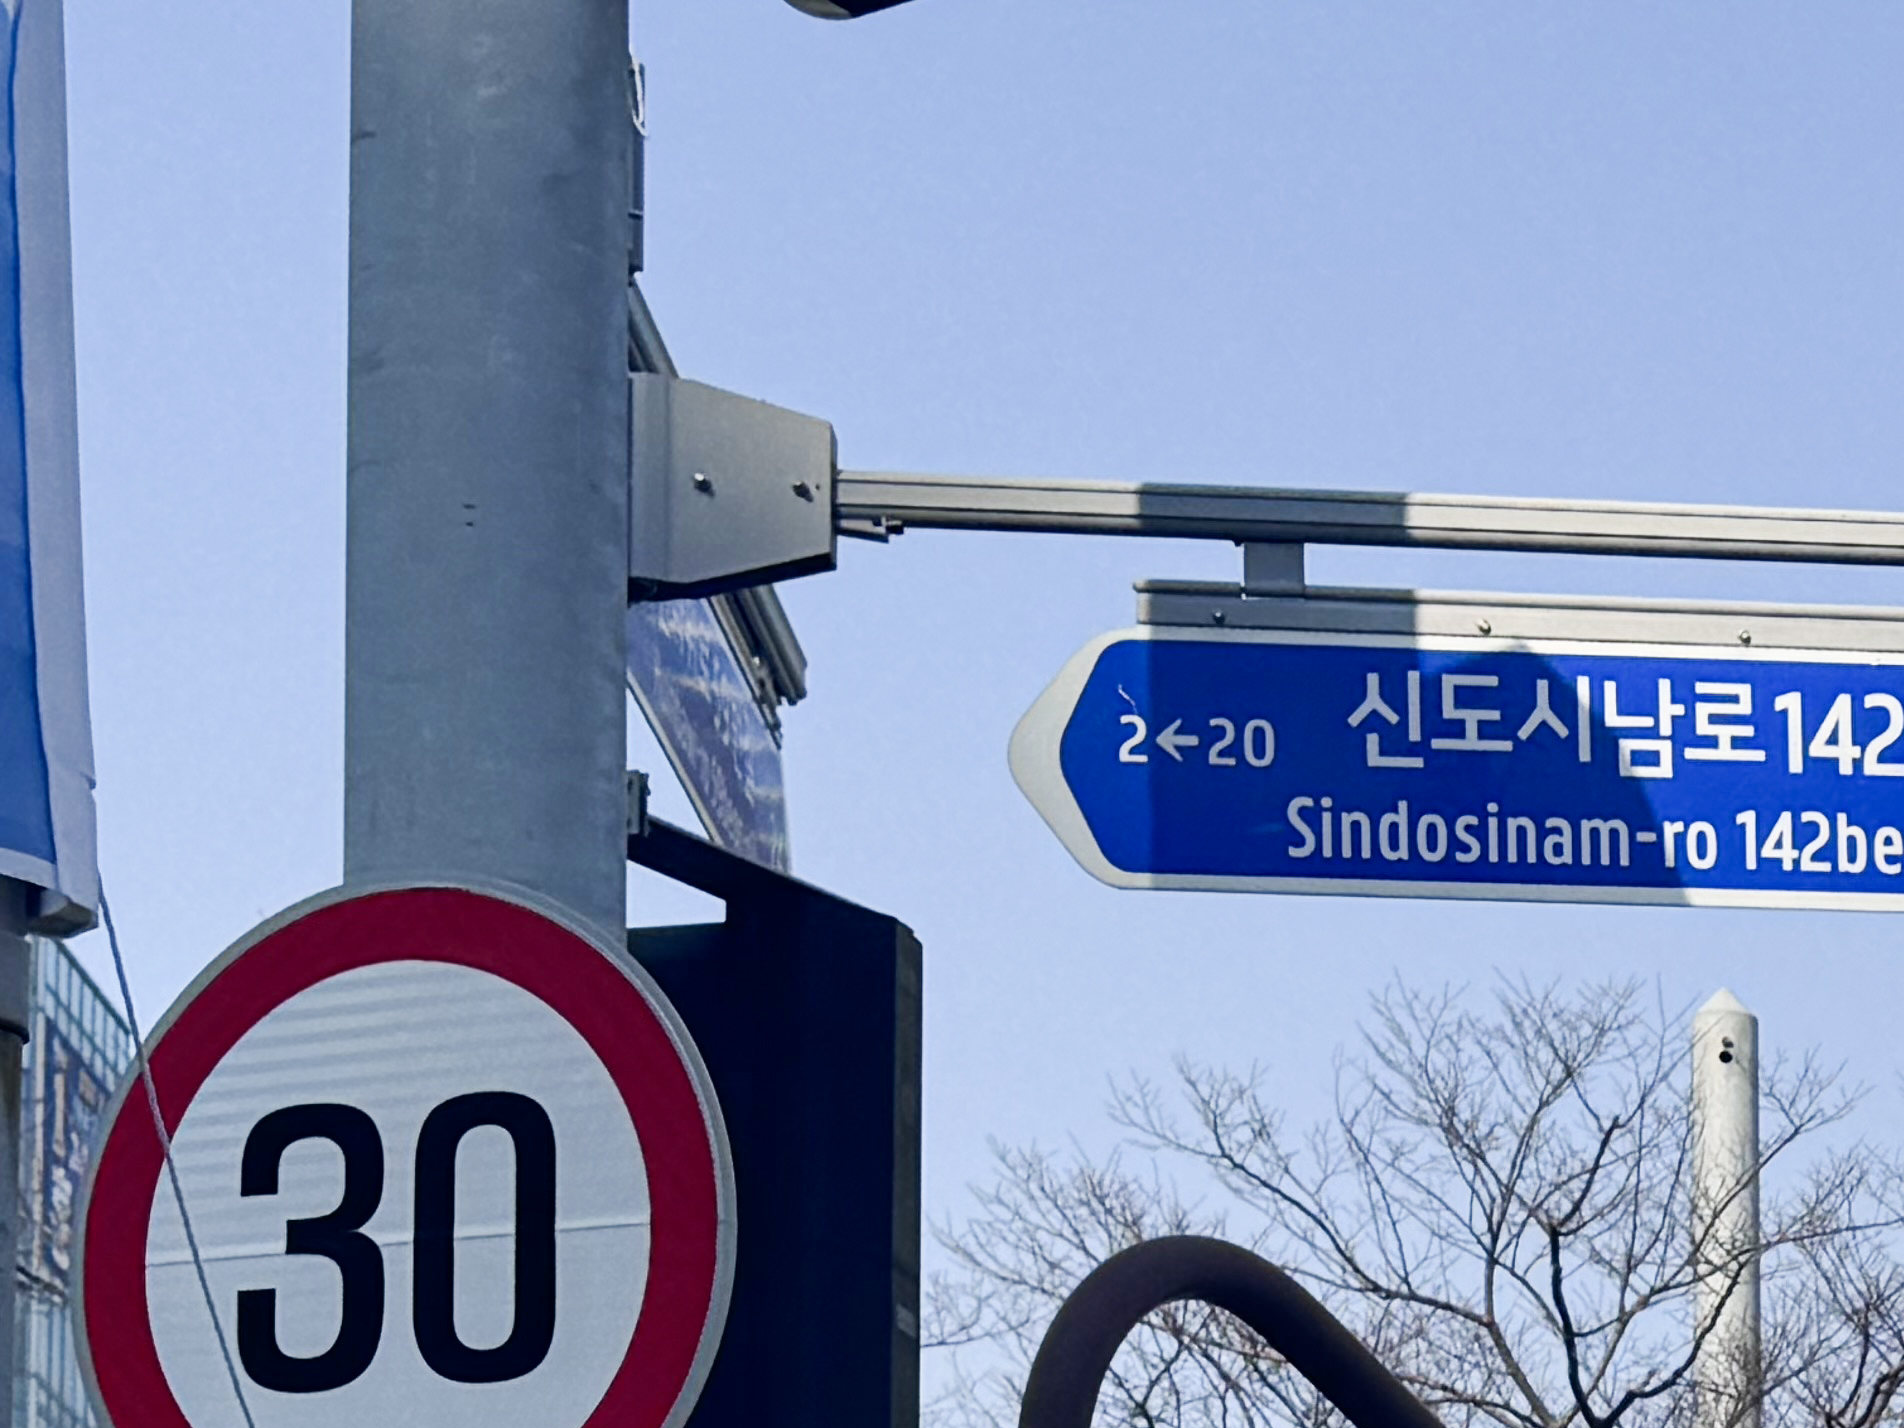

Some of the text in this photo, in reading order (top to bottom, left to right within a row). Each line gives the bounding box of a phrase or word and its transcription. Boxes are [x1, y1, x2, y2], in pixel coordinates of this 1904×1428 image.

[1208, 717, 1275, 767] 20
[1287, 796, 1718, 872] Sindosinam-ro
[236, 1090, 558, 1394] 30
